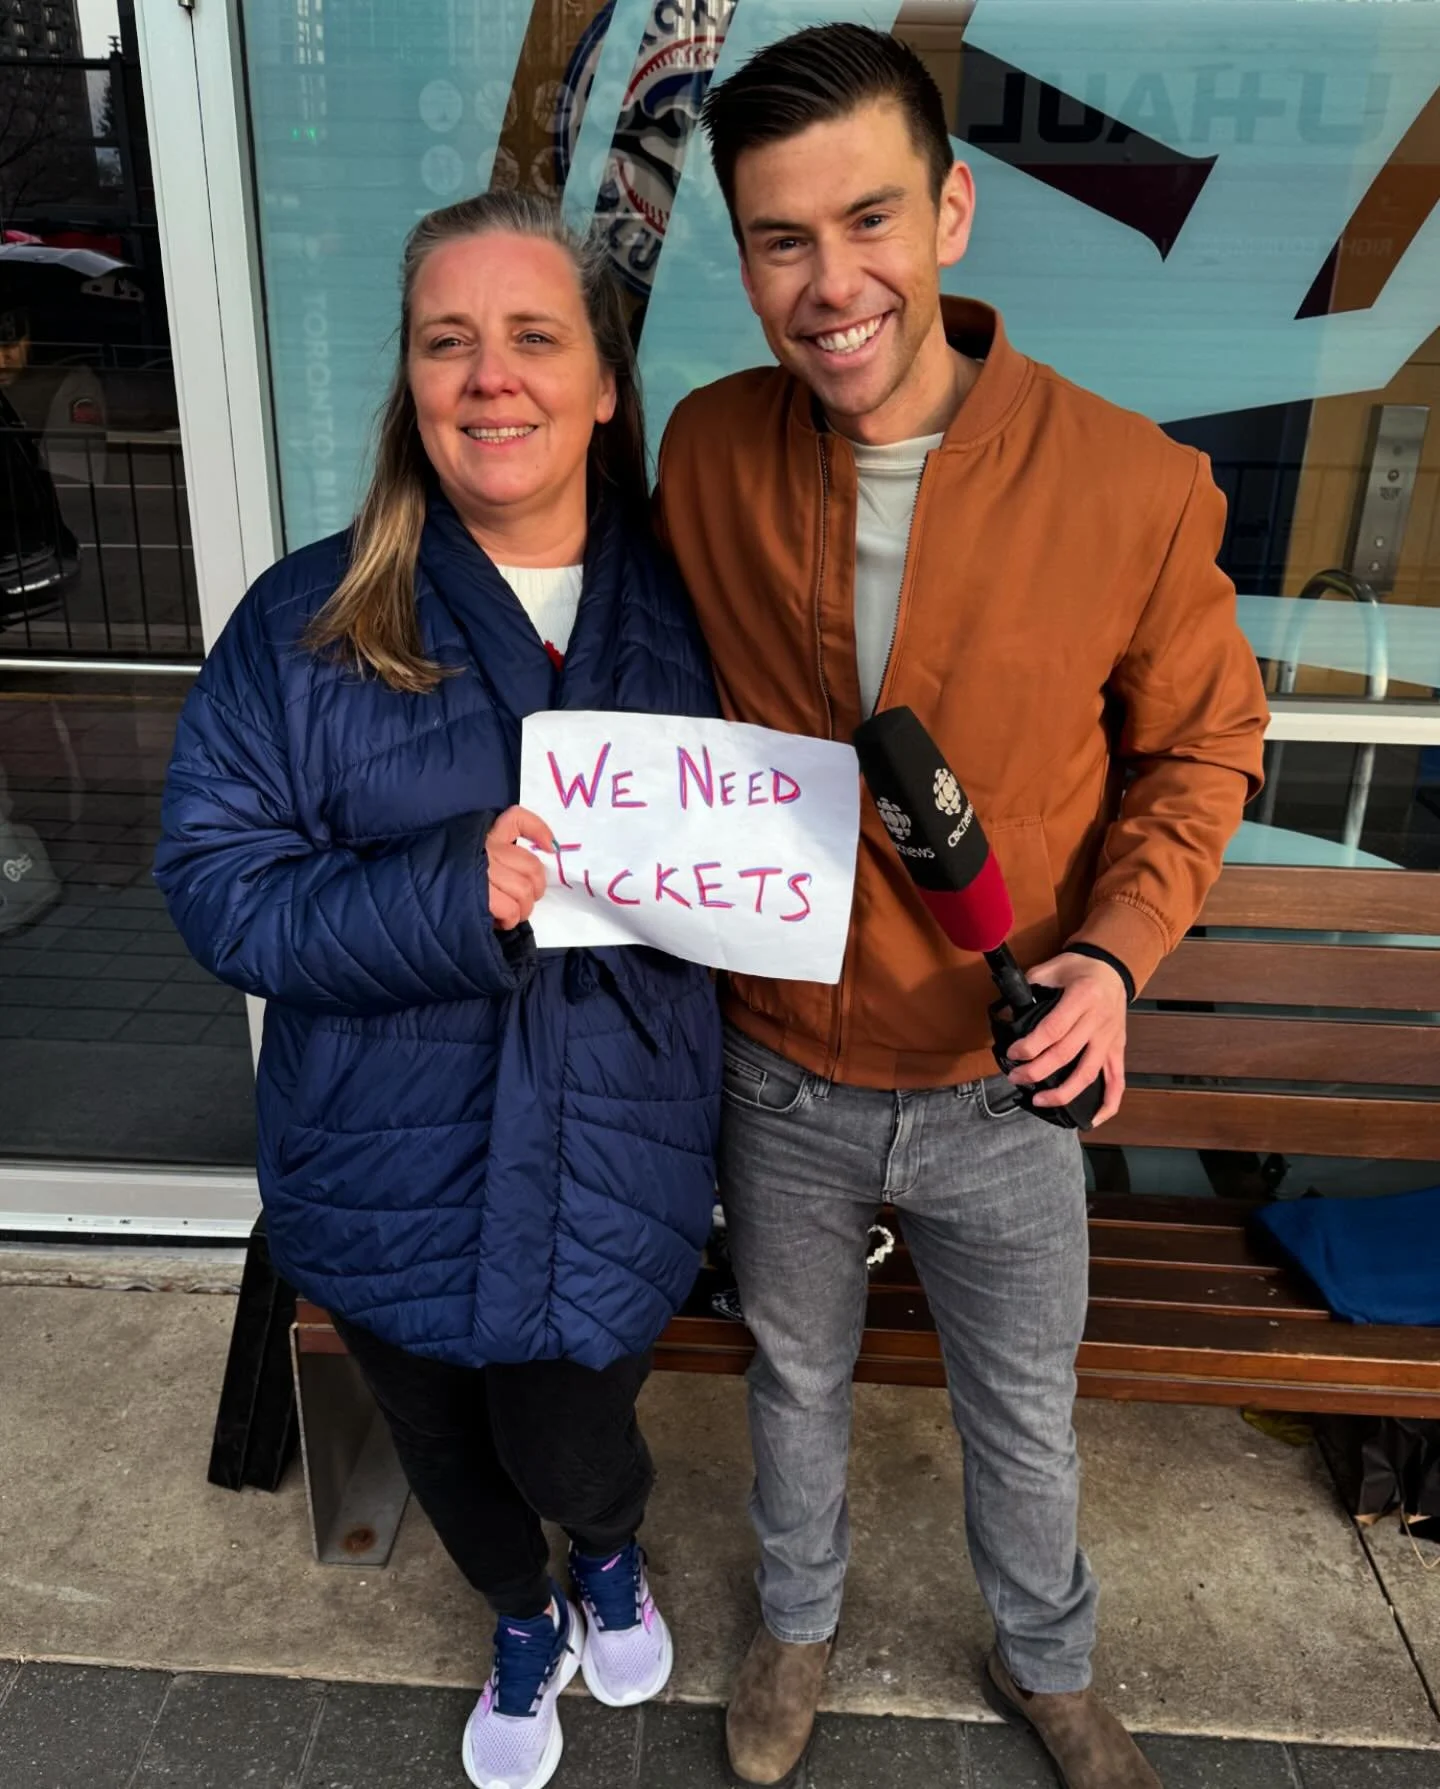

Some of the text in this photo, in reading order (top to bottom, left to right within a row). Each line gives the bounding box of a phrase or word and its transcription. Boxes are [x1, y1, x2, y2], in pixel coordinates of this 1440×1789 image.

[303, 293, 336, 459] TORONTO
[547, 742, 802, 810] WE NEED
[530, 842, 813, 922] TICKETS
